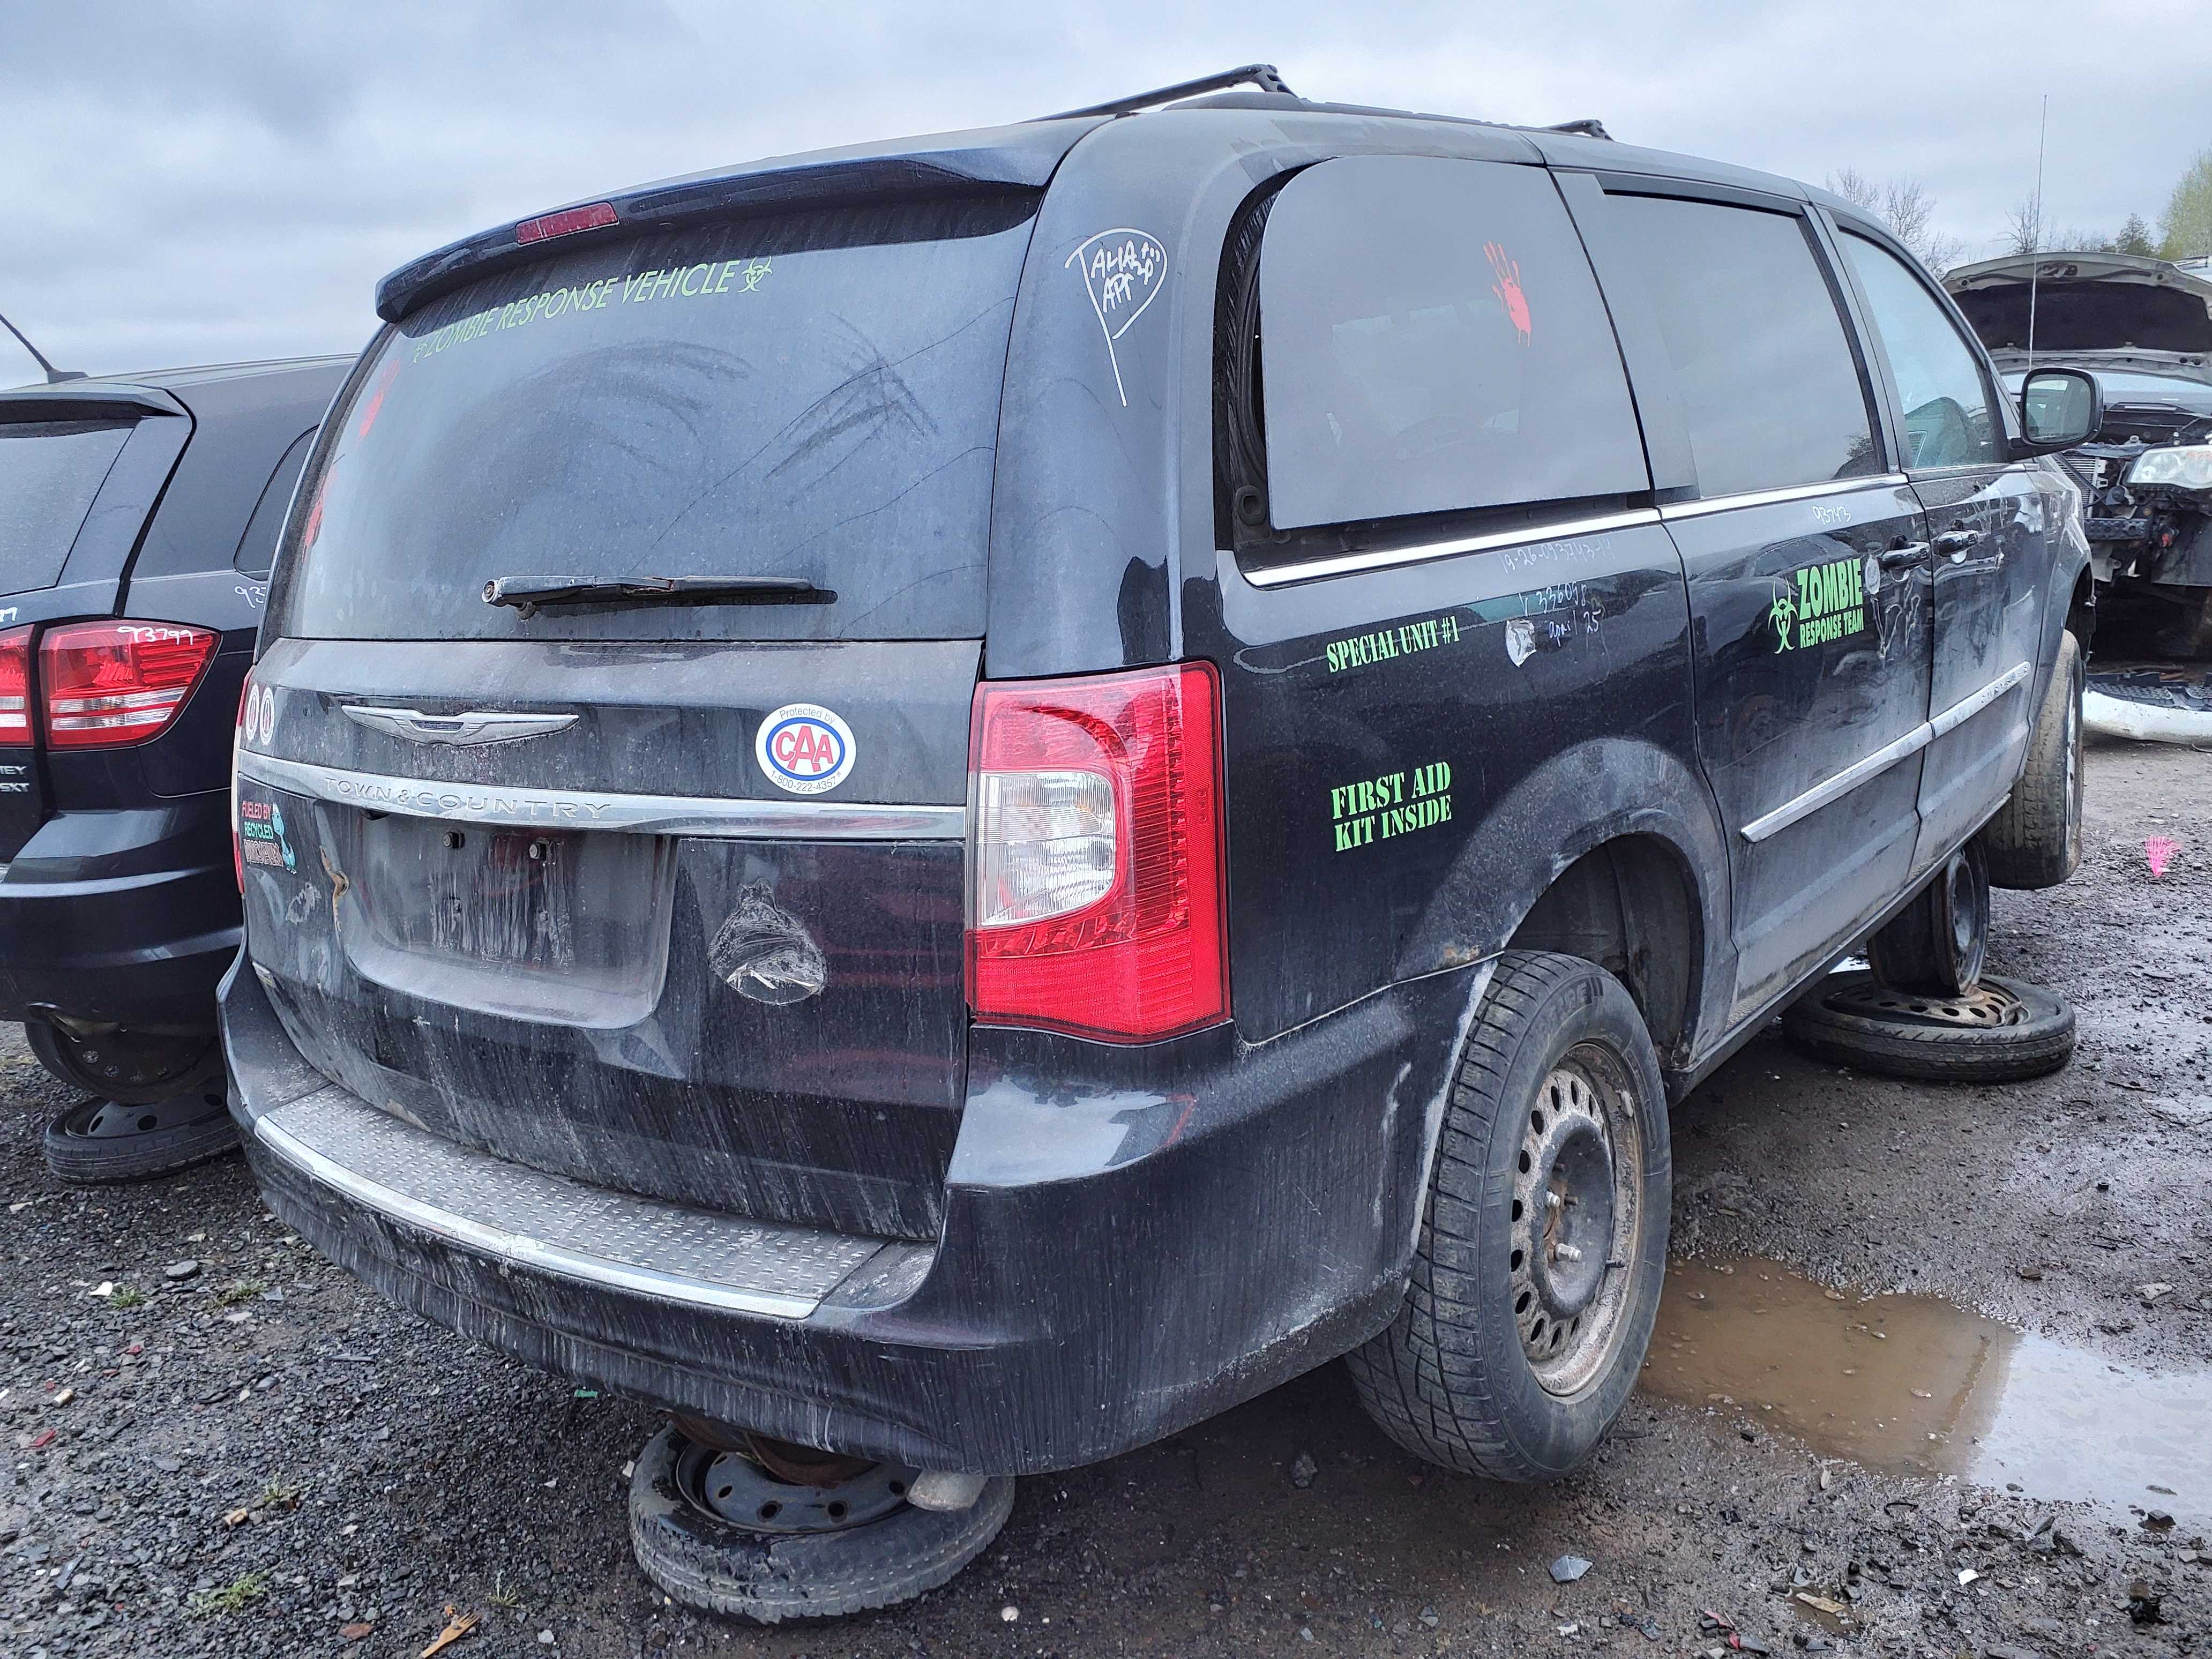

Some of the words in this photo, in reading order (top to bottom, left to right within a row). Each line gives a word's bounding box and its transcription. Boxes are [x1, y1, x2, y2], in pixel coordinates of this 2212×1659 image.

[423, 307, 499, 358] ZOMBIE
[495, 277, 619, 332] RESPONSE
[622, 260, 741, 305] VEHICLE
[1812, 505, 1851, 525] 93743
[1797, 558, 1864, 621] ZOMBIE
[117, 626, 193, 646] 93799
[1583, 608, 1602, 634] 25
[1799, 613, 1842, 649] RESPONSE
[1843, 608, 1865, 637] TEAM
[1326, 629, 1400, 674] SPECIAL
[1398, 619, 1439, 654] UNIT
[1441, 615, 1460, 645] #1
[780, 707, 823, 720] Protected
[824, 712, 836, 724] by
[775, 725, 834, 773] CAA
[771, 770, 836, 792] 1-800-222-4357
[1331, 772, 1405, 820] FIRST
[1411, 761, 1452, 799] AID
[263, 803, 272, 820] BY
[1334, 815, 1376, 852] KIT
[1381, 794, 1452, 839] INSIDE
[244, 821, 274, 840] RECYCLED
